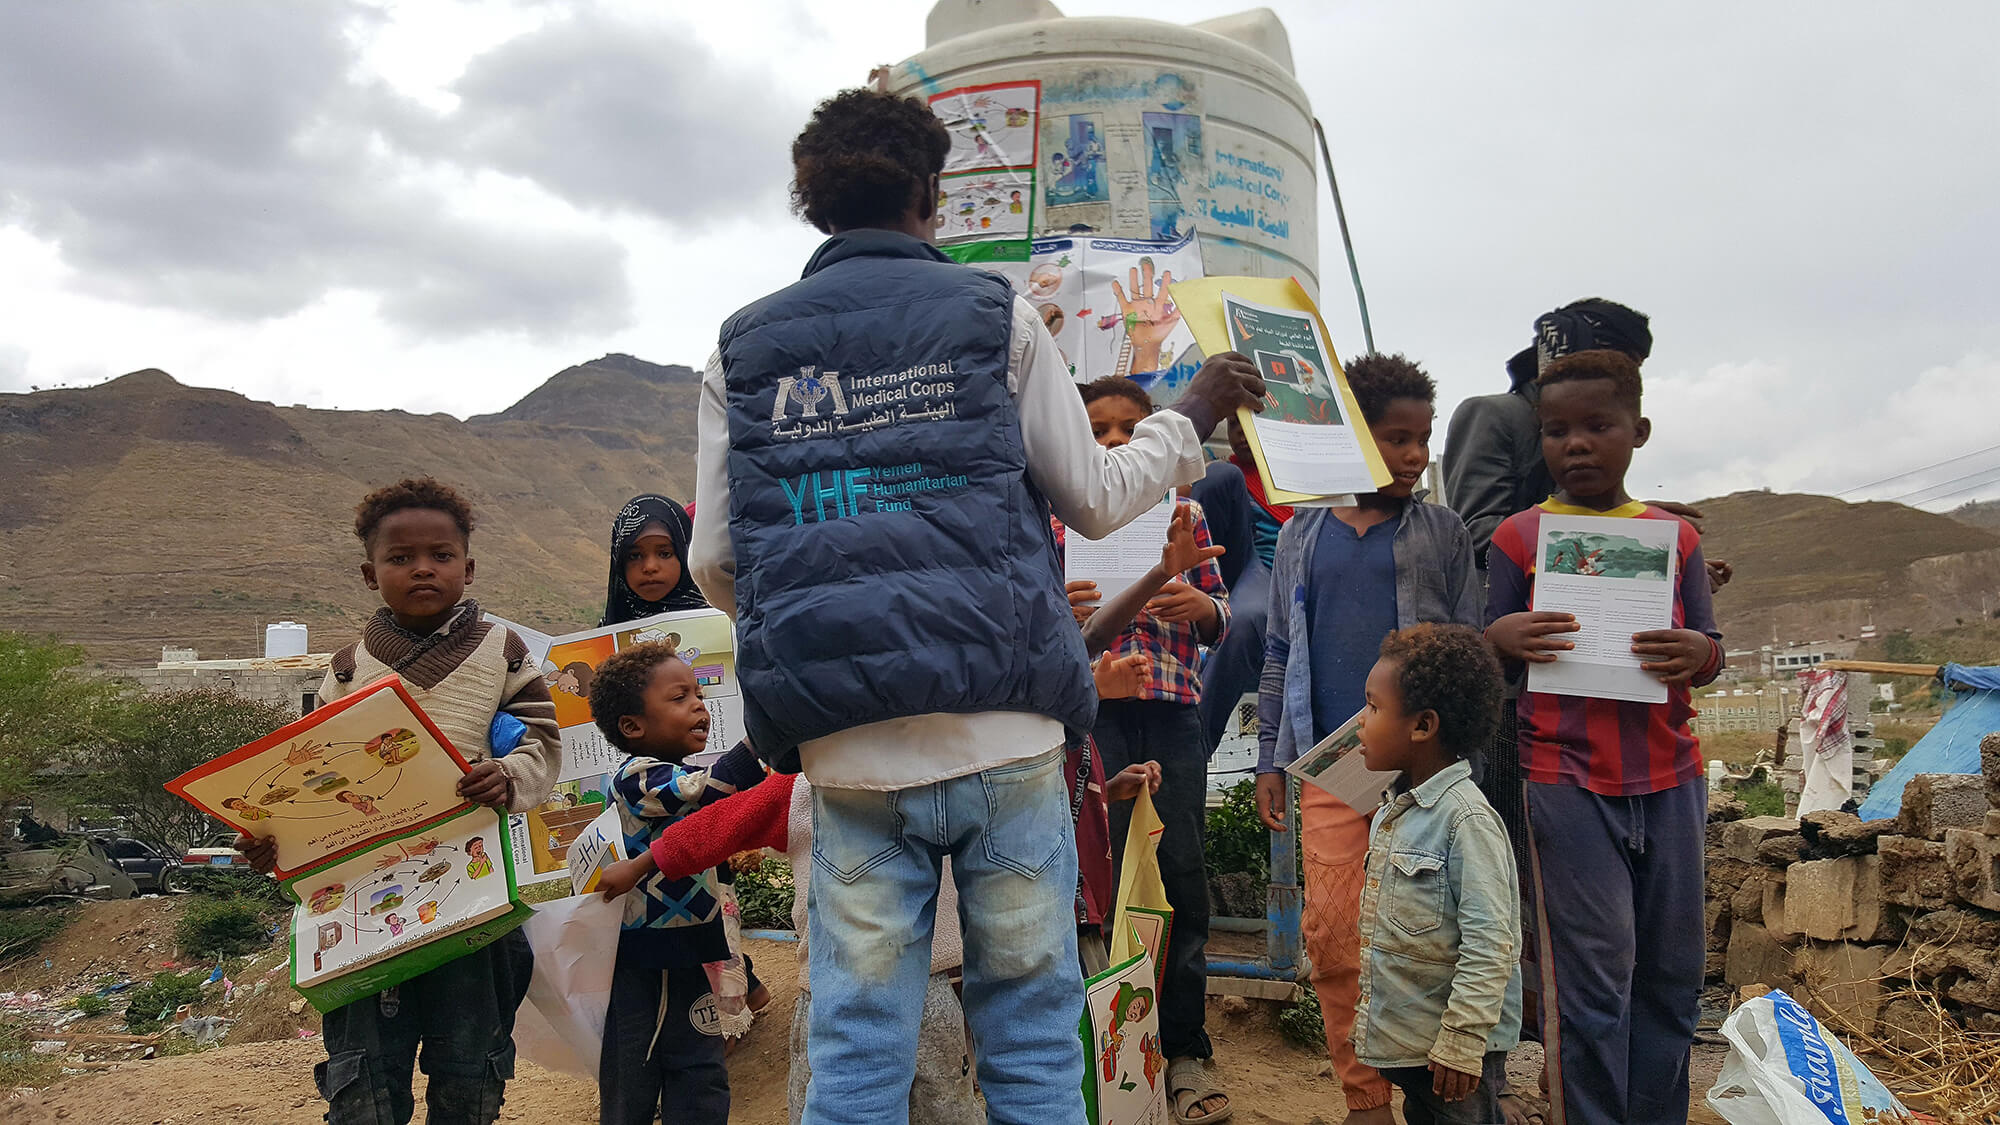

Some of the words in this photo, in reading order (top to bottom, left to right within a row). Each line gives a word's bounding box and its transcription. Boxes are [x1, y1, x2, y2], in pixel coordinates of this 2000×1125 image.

[851, 360, 954, 389] International
[852, 386, 907, 409] Medical
[910, 380, 955, 399] Corps
[872, 462, 921, 479] Yemen
[874, 474, 967, 496] Humanitarian
[779, 467, 871, 525] YHF
[876, 500, 912, 513] Fund
[319, 834, 328, 842] من
[518, 827, 528, 863] International
[579, 827, 606, 874] YHF
